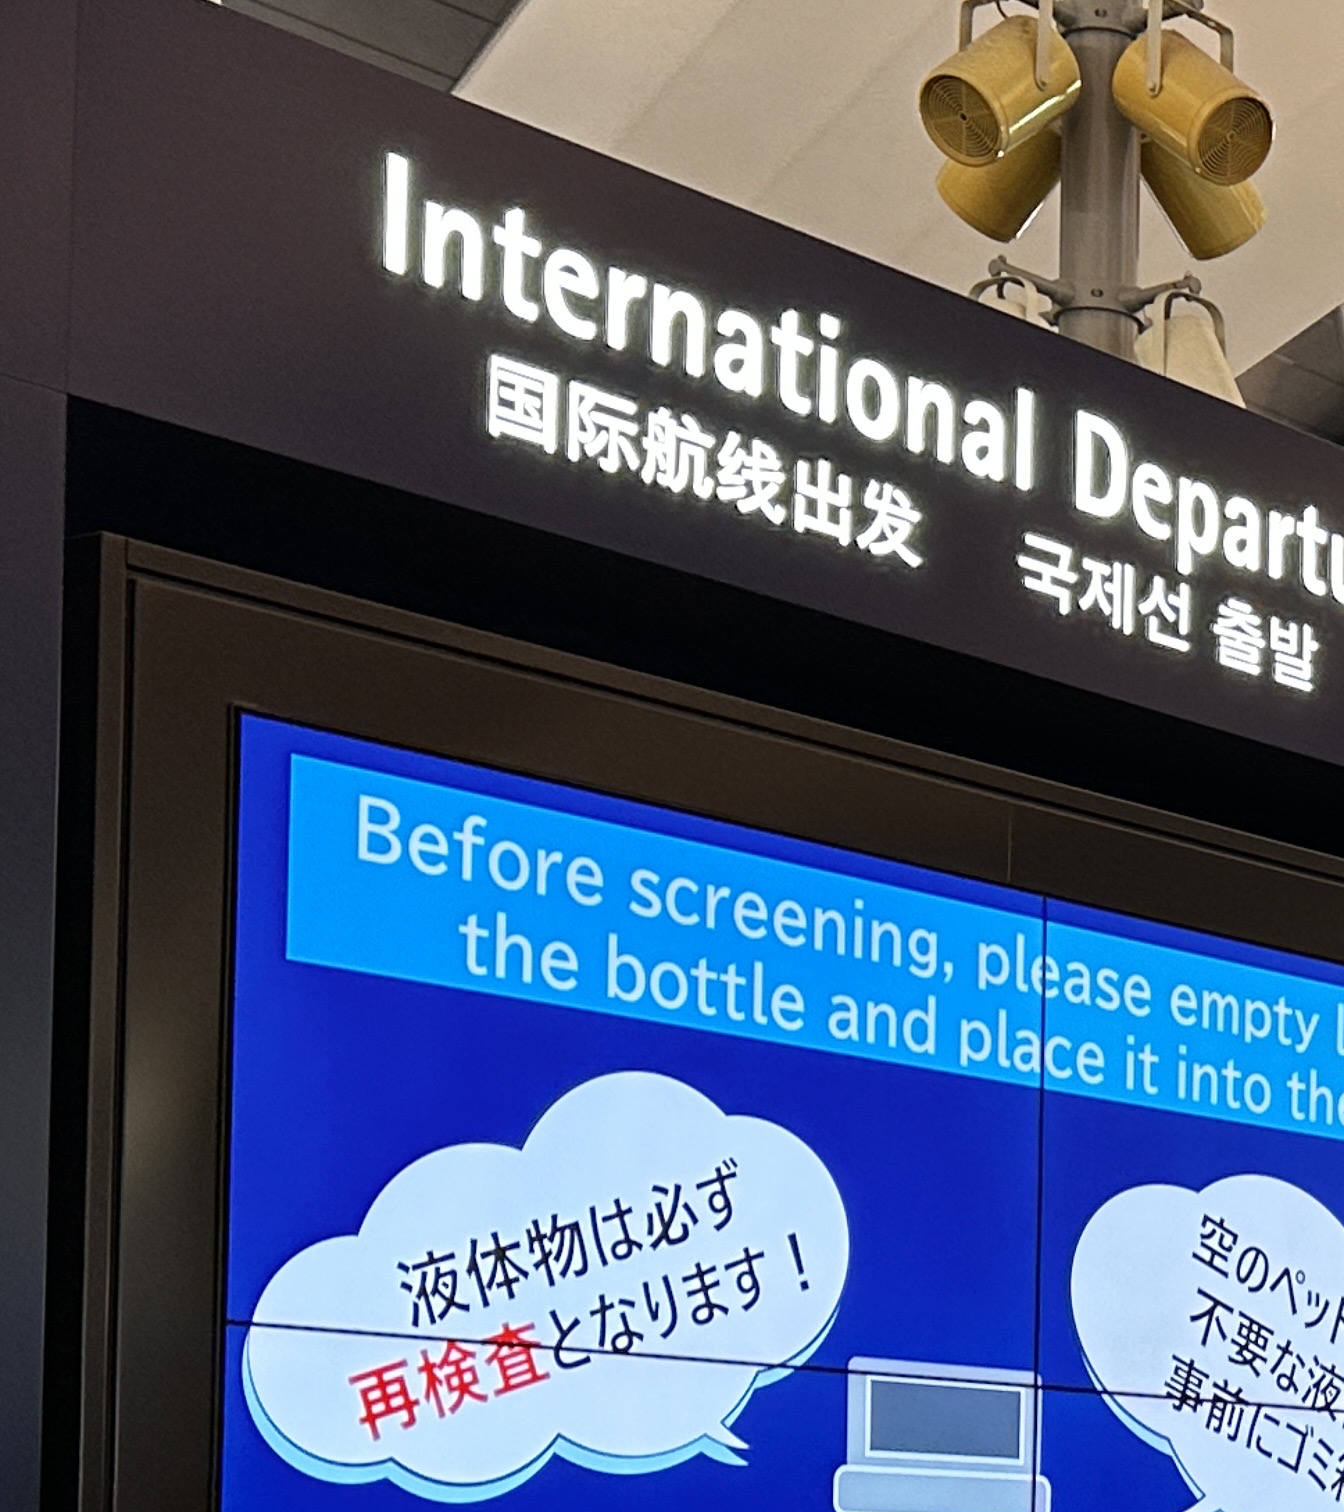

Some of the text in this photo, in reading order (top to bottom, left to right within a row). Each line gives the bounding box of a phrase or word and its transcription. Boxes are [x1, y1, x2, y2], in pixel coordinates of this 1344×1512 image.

[383, 153, 1035, 491] International
[487, 356, 924, 569] 国际航线出发
[1017, 532, 1319, 692] 국제선 출발
[357, 794, 603, 906] Before
[629, 867, 953, 984] screening,
[978, 934, 1150, 1017] please
[1170, 984, 1320, 1054] empty
[459, 912, 578, 991] the
[607, 934, 804, 1030] bottle
[828, 994, 936, 1054] and
[959, 1009, 1104, 1084] place
[1126, 1035, 1158, 1095] it
[1178, 1045, 1271, 1114] into
[348, 1232, 810, 1442] 再検査となります！
[397, 1158, 739, 1327] 液体物は必ず
